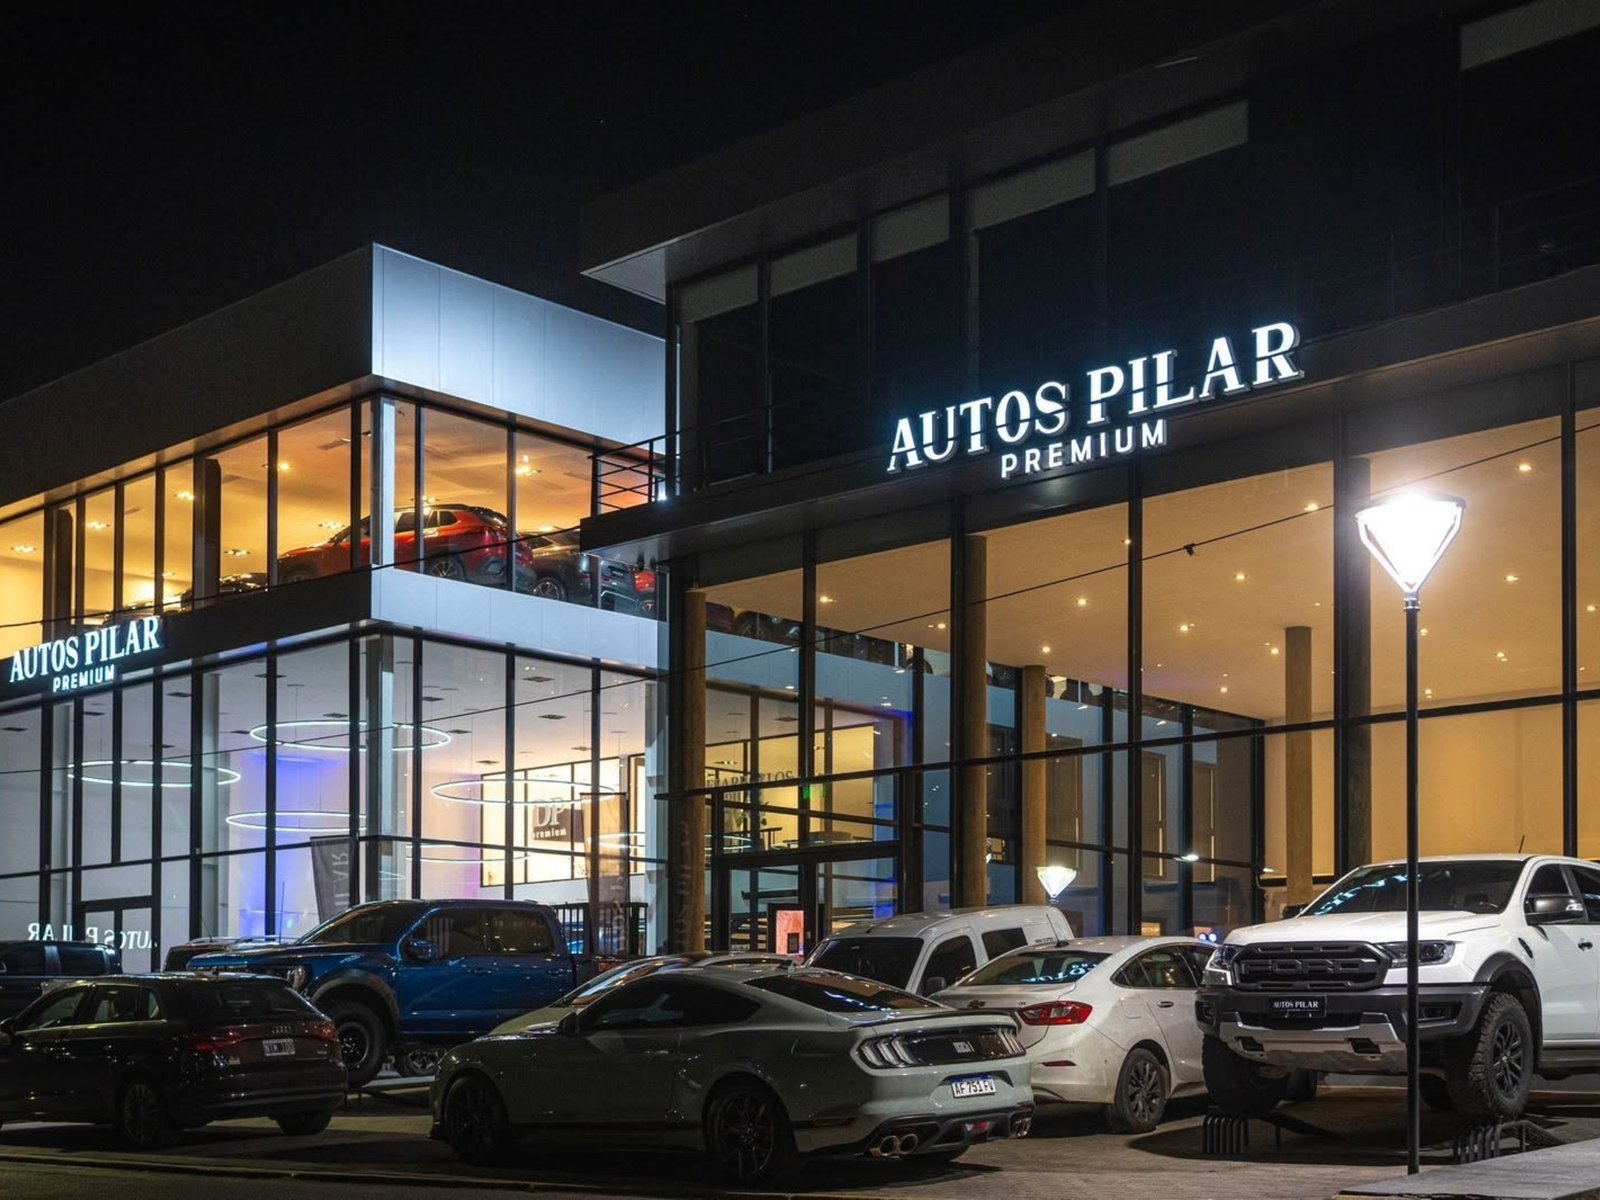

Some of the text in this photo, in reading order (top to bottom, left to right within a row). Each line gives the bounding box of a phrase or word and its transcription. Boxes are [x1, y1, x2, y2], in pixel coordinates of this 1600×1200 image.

[887, 321, 1305, 473] AUTOS PILAR
[1001, 418, 1168, 478] PREMIUM
[9, 615, 161, 683] AUTOS PILAR
[53, 665, 115, 692] PREMIUM
[1272, 1000, 1319, 1009] AUTOS PILAR
[966, 1080, 983, 1093] 751
